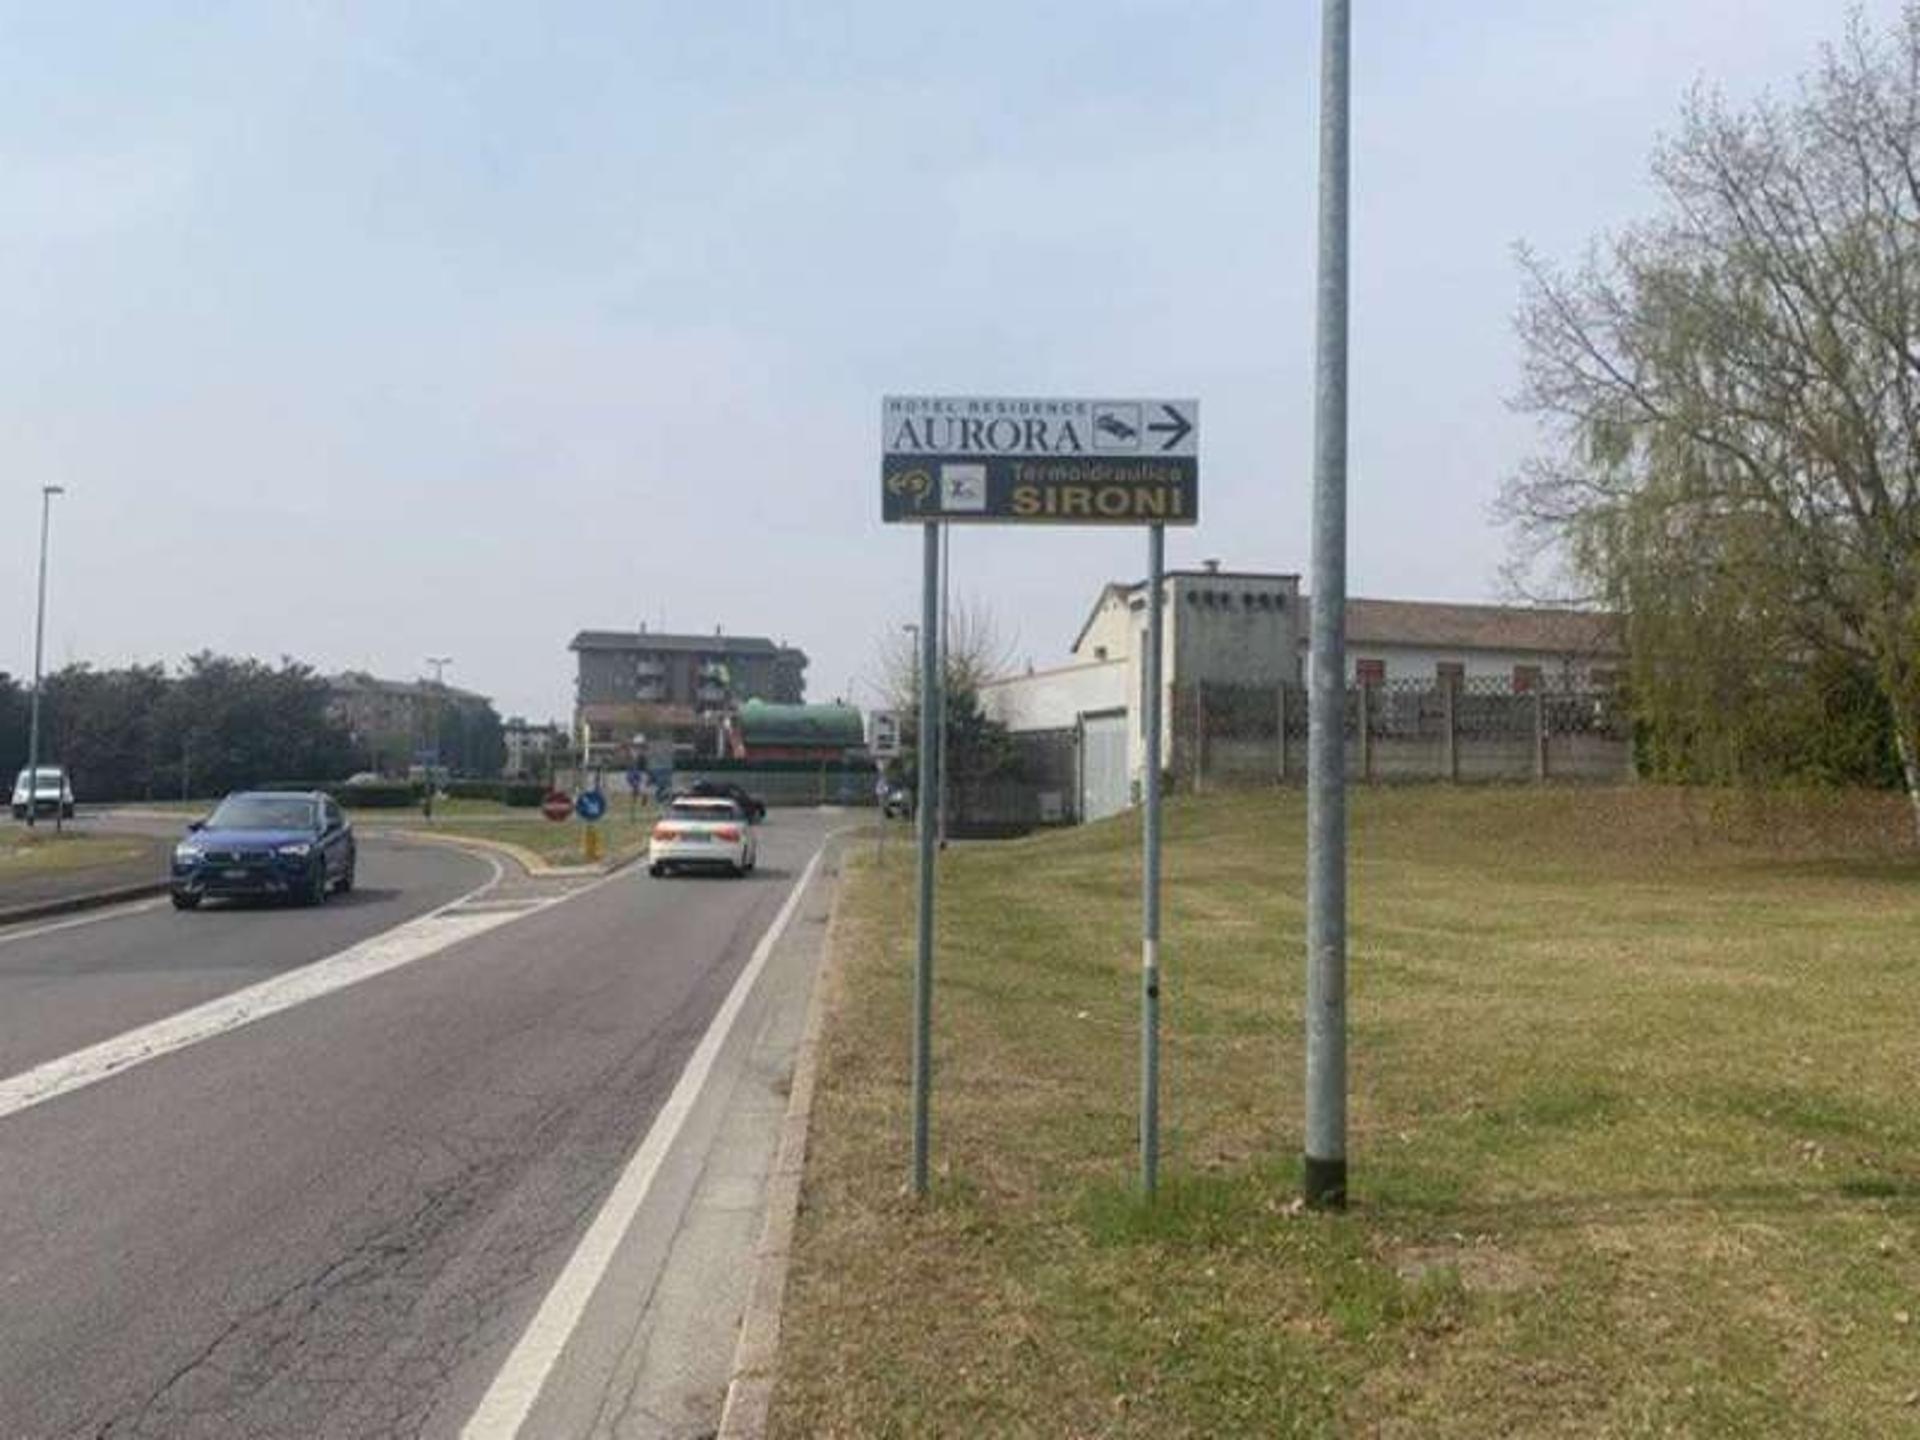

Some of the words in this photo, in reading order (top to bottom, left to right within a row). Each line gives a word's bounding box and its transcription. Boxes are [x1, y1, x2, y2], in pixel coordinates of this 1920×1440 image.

[968, 402, 1086, 414] RESIDENCE
[893, 417, 1081, 450] AURORA
[1013, 486, 1182, 515] SIRONI
